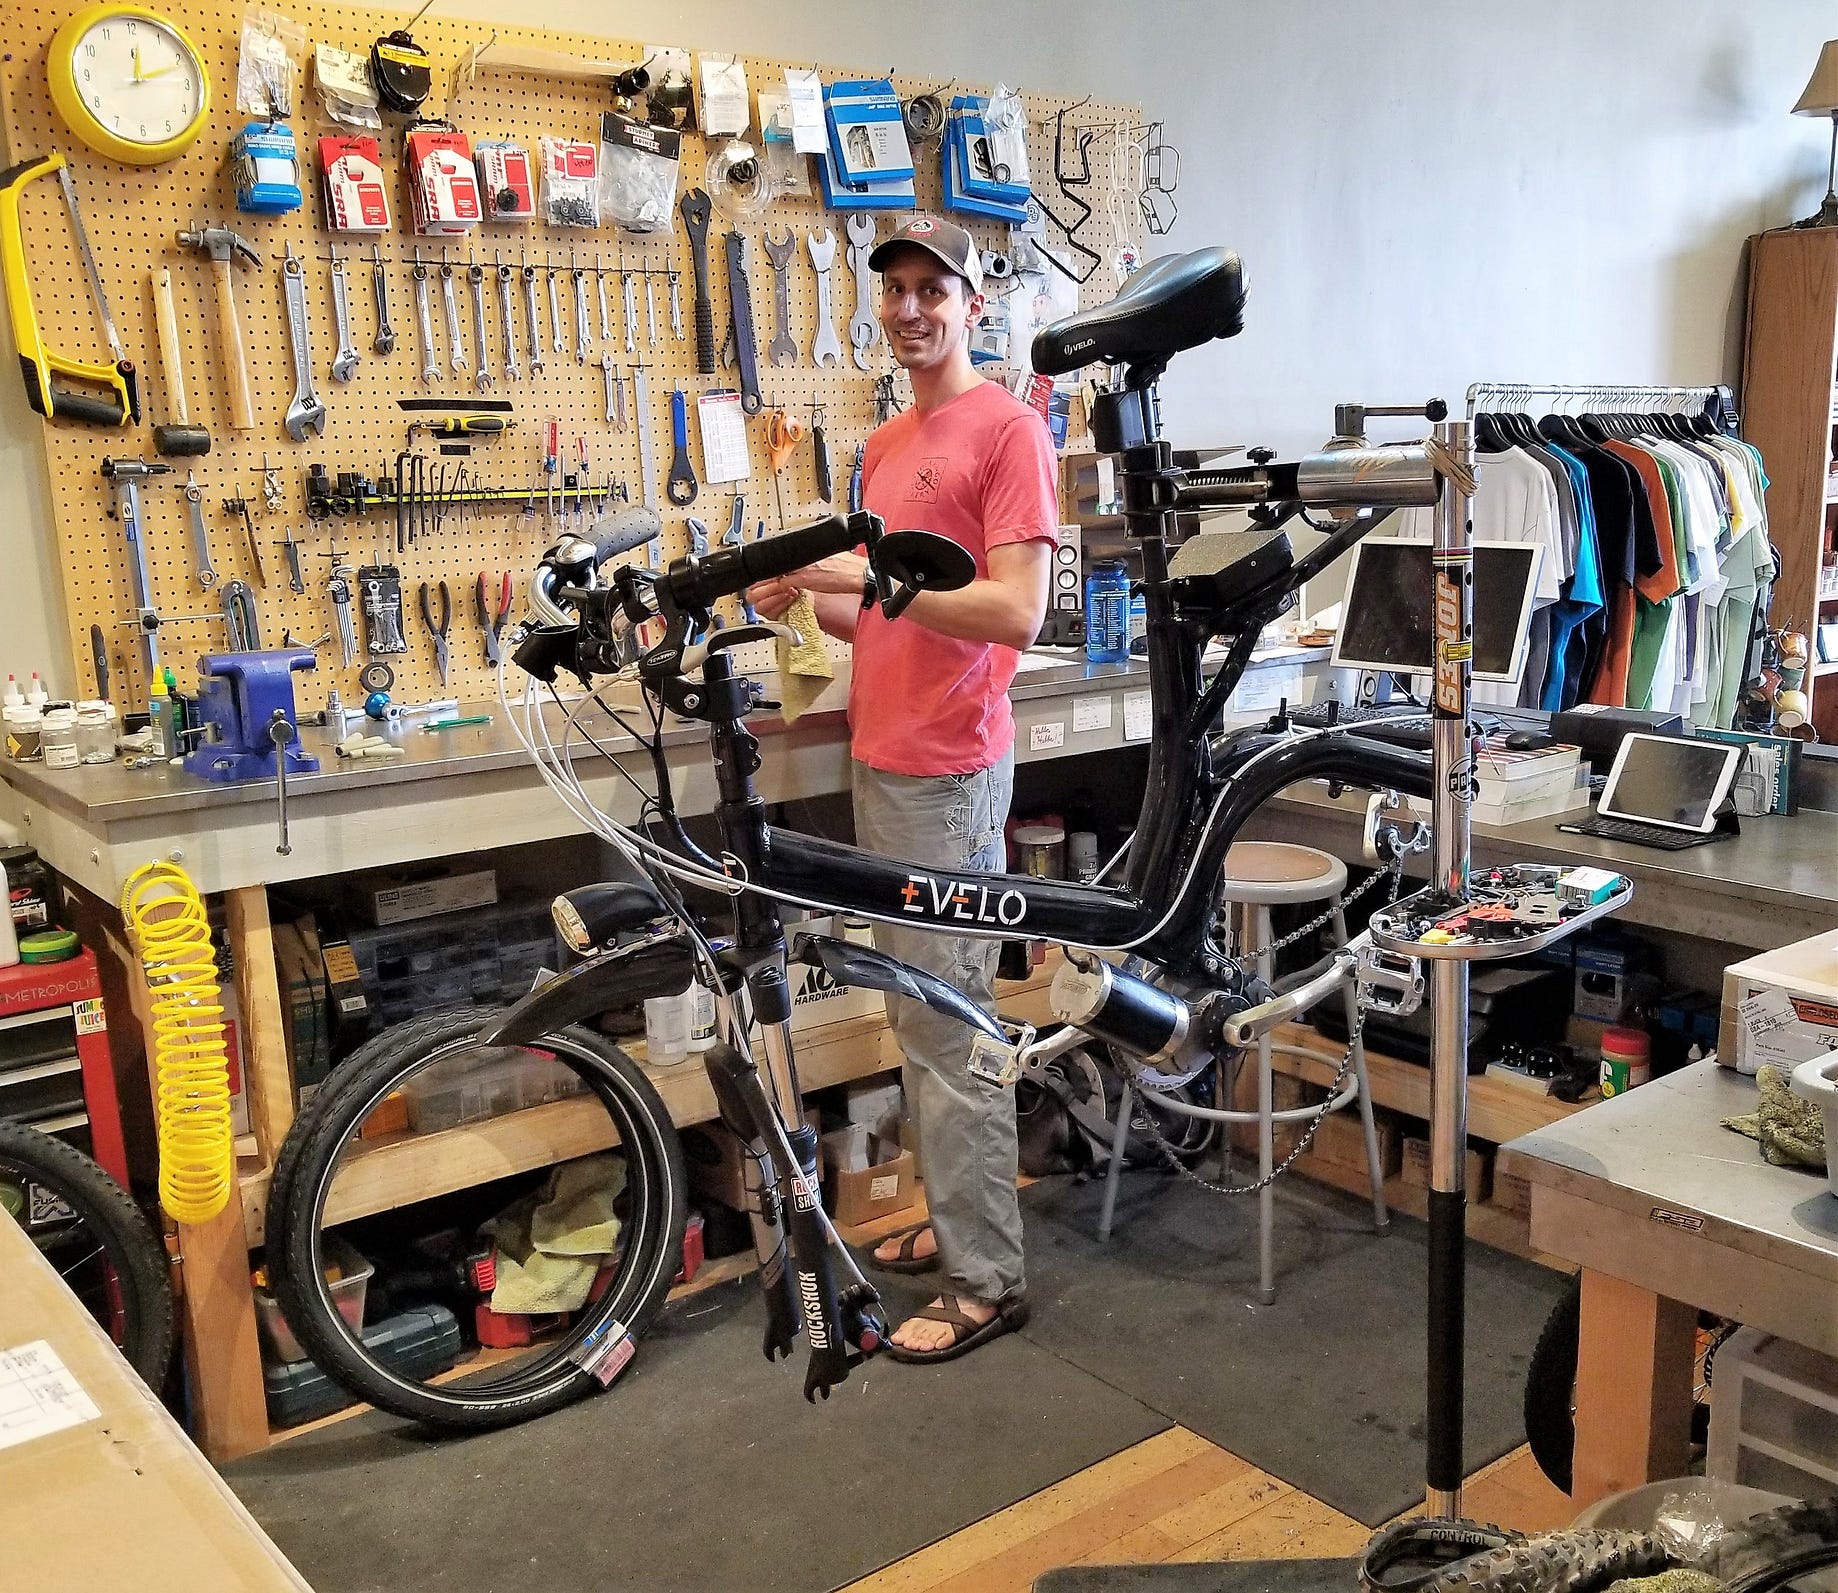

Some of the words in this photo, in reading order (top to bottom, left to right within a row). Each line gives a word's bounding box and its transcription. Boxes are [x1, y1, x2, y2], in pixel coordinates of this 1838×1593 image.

[102, 28, 111, 41] 11
[126, 22, 137, 36] 12
[157, 32, 161, 46] 1
[85, 43, 96, 58] 10
[175, 53, 181, 66] 2
[83, 68, 91, 82] 9
[184, 78, 191, 91] 3
[94, 95, 101, 109] 8
[181, 103, 187, 116] 4
[114, 115, 121, 129] 7
[165, 119, 172, 133] 5
[140, 124, 147, 137] 6
[1772, 777, 1781, 810] order
[901, 874, 1027, 926] EVELO
[796, 965, 837, 997] AC
[795, 986, 849, 1006] HARDWARE
[798, 1270, 828, 1349] ROCKSHOX
